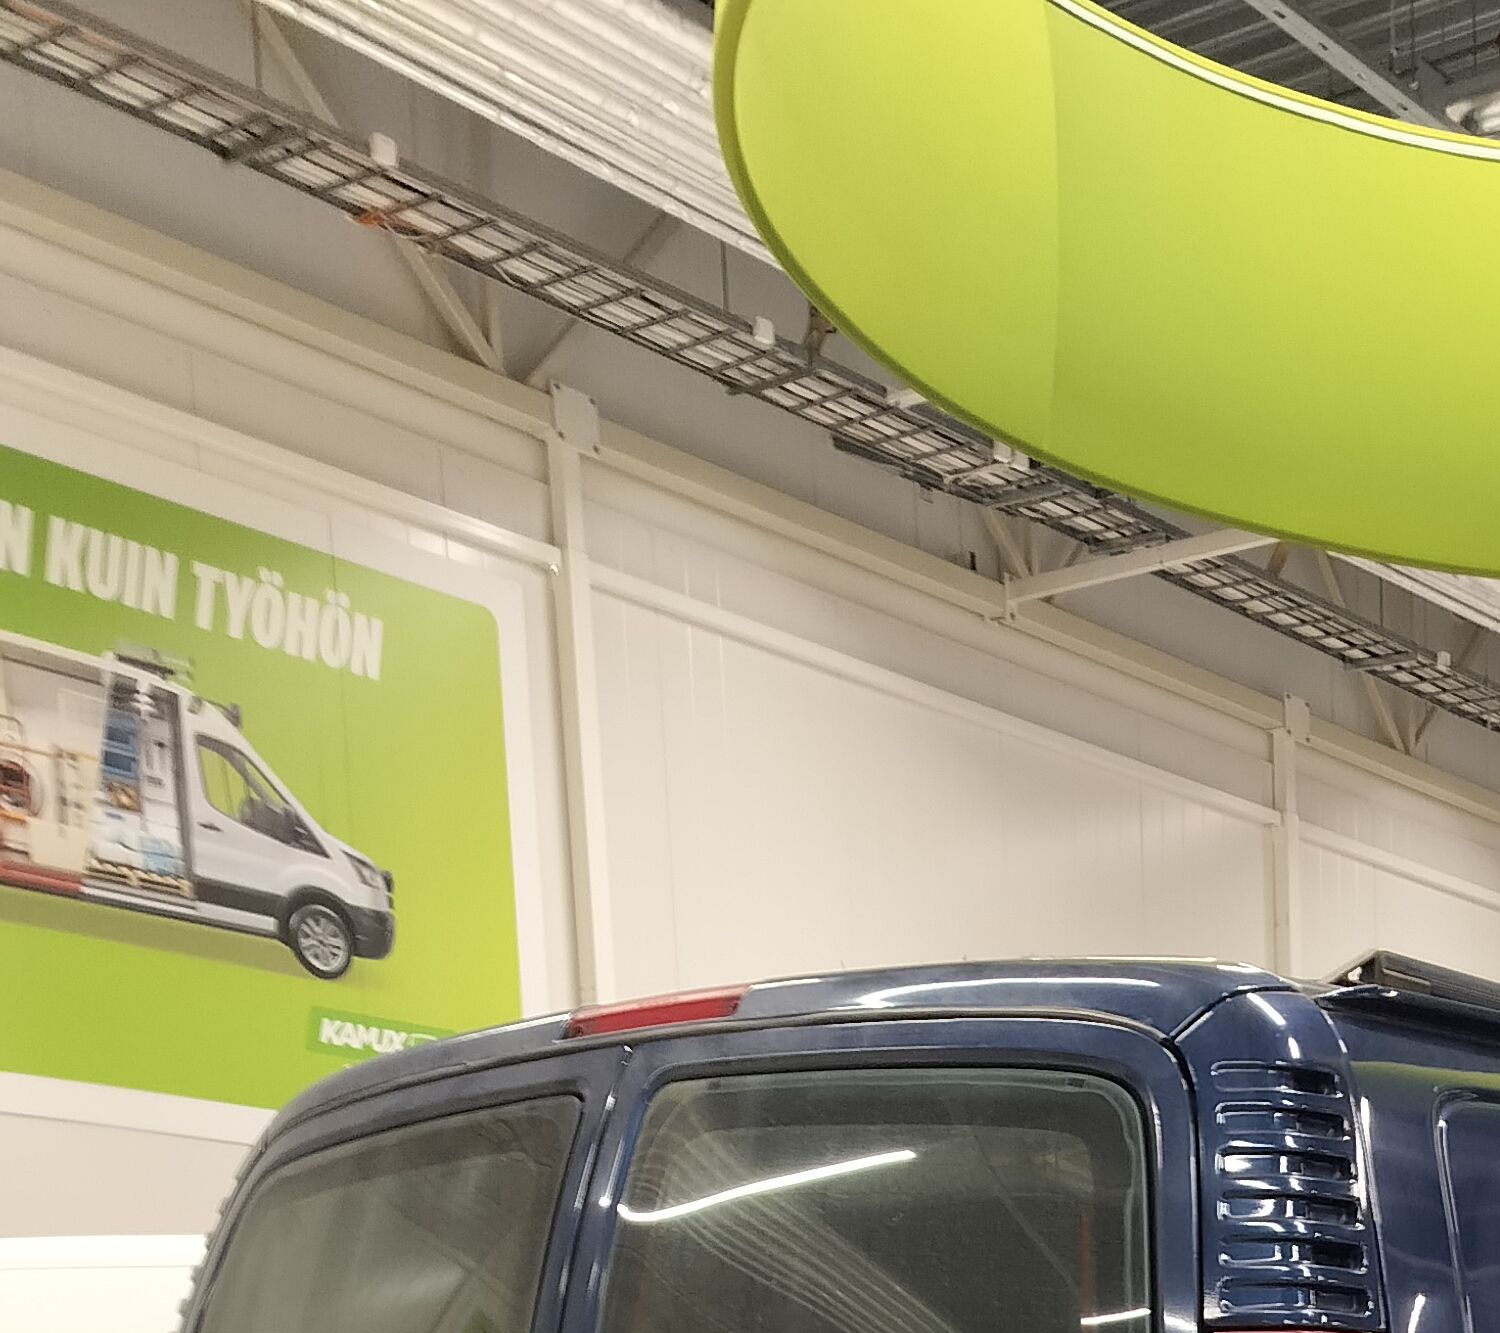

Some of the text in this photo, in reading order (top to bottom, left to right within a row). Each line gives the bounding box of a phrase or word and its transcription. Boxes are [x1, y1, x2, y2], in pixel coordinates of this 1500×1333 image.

[44, 514, 180, 620] KUIN
[190, 559, 384, 681] TYÖHÖN
[318, 1017, 408, 1054] KAMUX
